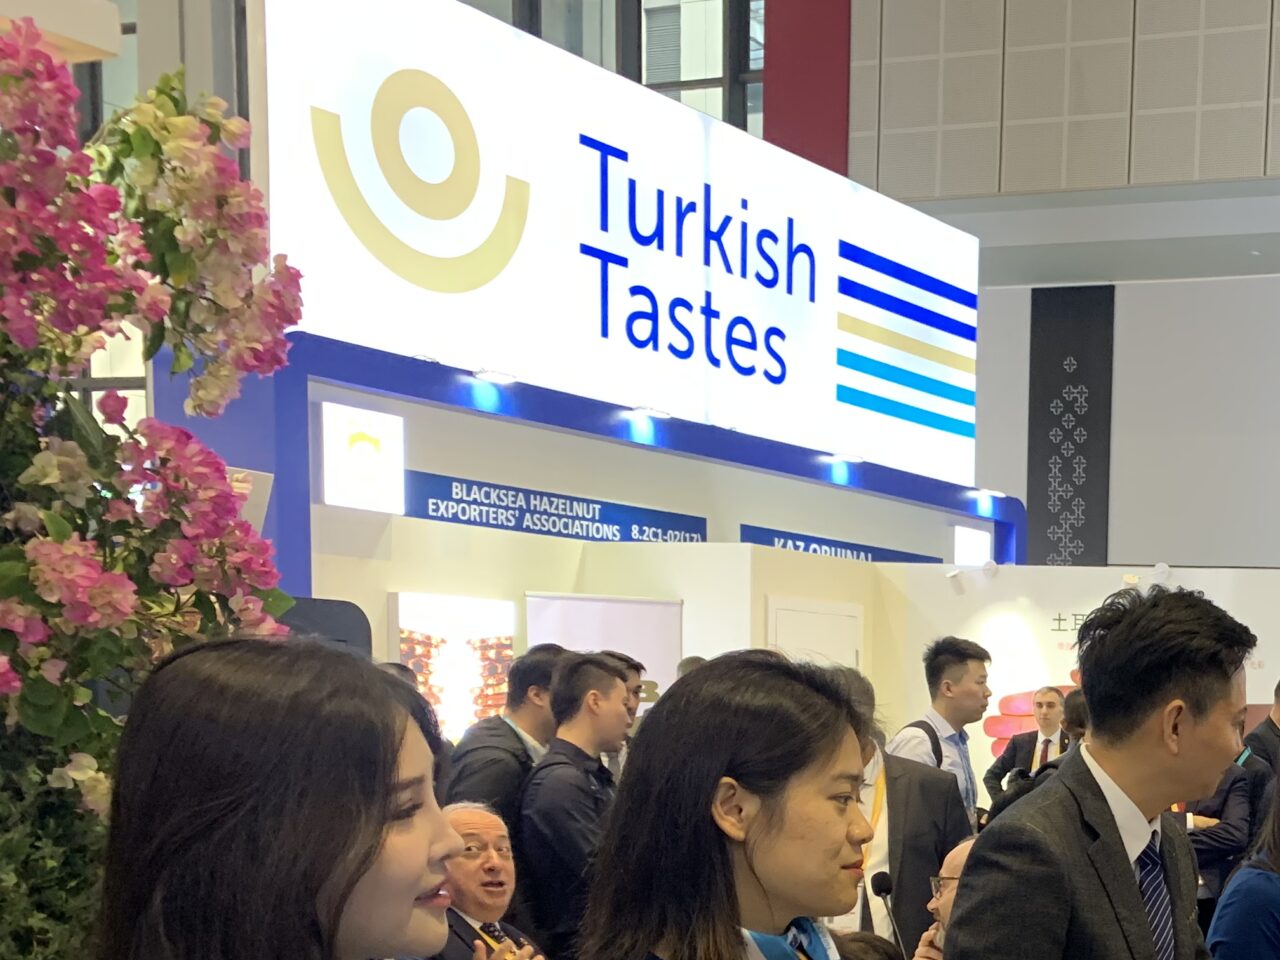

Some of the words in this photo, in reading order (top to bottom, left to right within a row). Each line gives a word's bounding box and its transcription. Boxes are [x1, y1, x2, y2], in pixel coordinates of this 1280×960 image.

[579, 133, 816, 303] Turkish
[579, 242, 787, 385] Tastes
[428, 498, 519, 527] EXPORTERS'
[522, 513, 621, 541] ASSOCIATIONS
[451, 481, 526, 509] BLACKSEA
[530, 494, 602, 520] HAZELNUT
